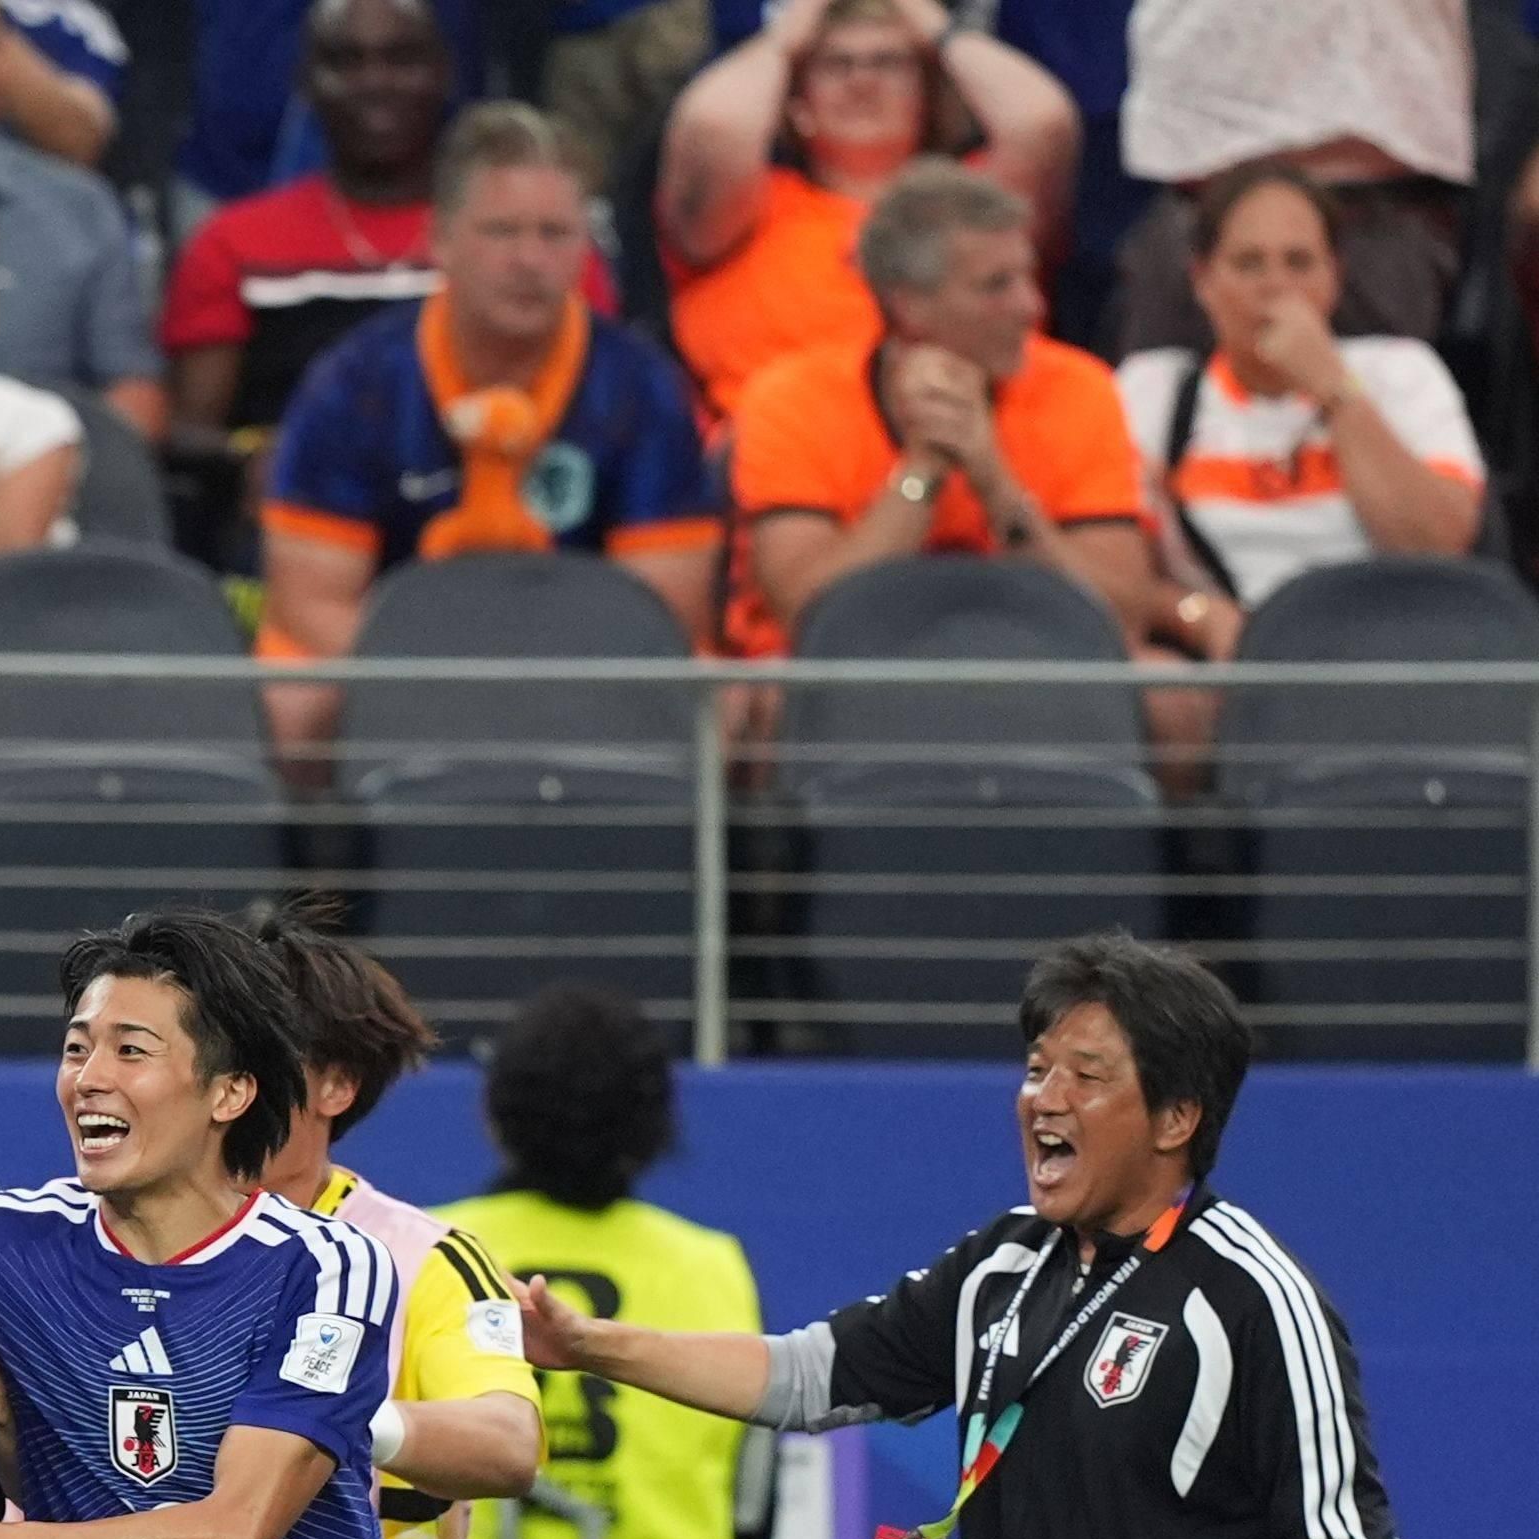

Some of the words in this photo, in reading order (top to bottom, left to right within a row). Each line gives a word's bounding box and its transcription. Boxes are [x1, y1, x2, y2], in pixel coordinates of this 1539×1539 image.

[1112, 1256, 1141, 1284] FIFA
[1076, 1280, 1119, 1325] WORLD
[127, 1391, 160, 1401] JAPAN
